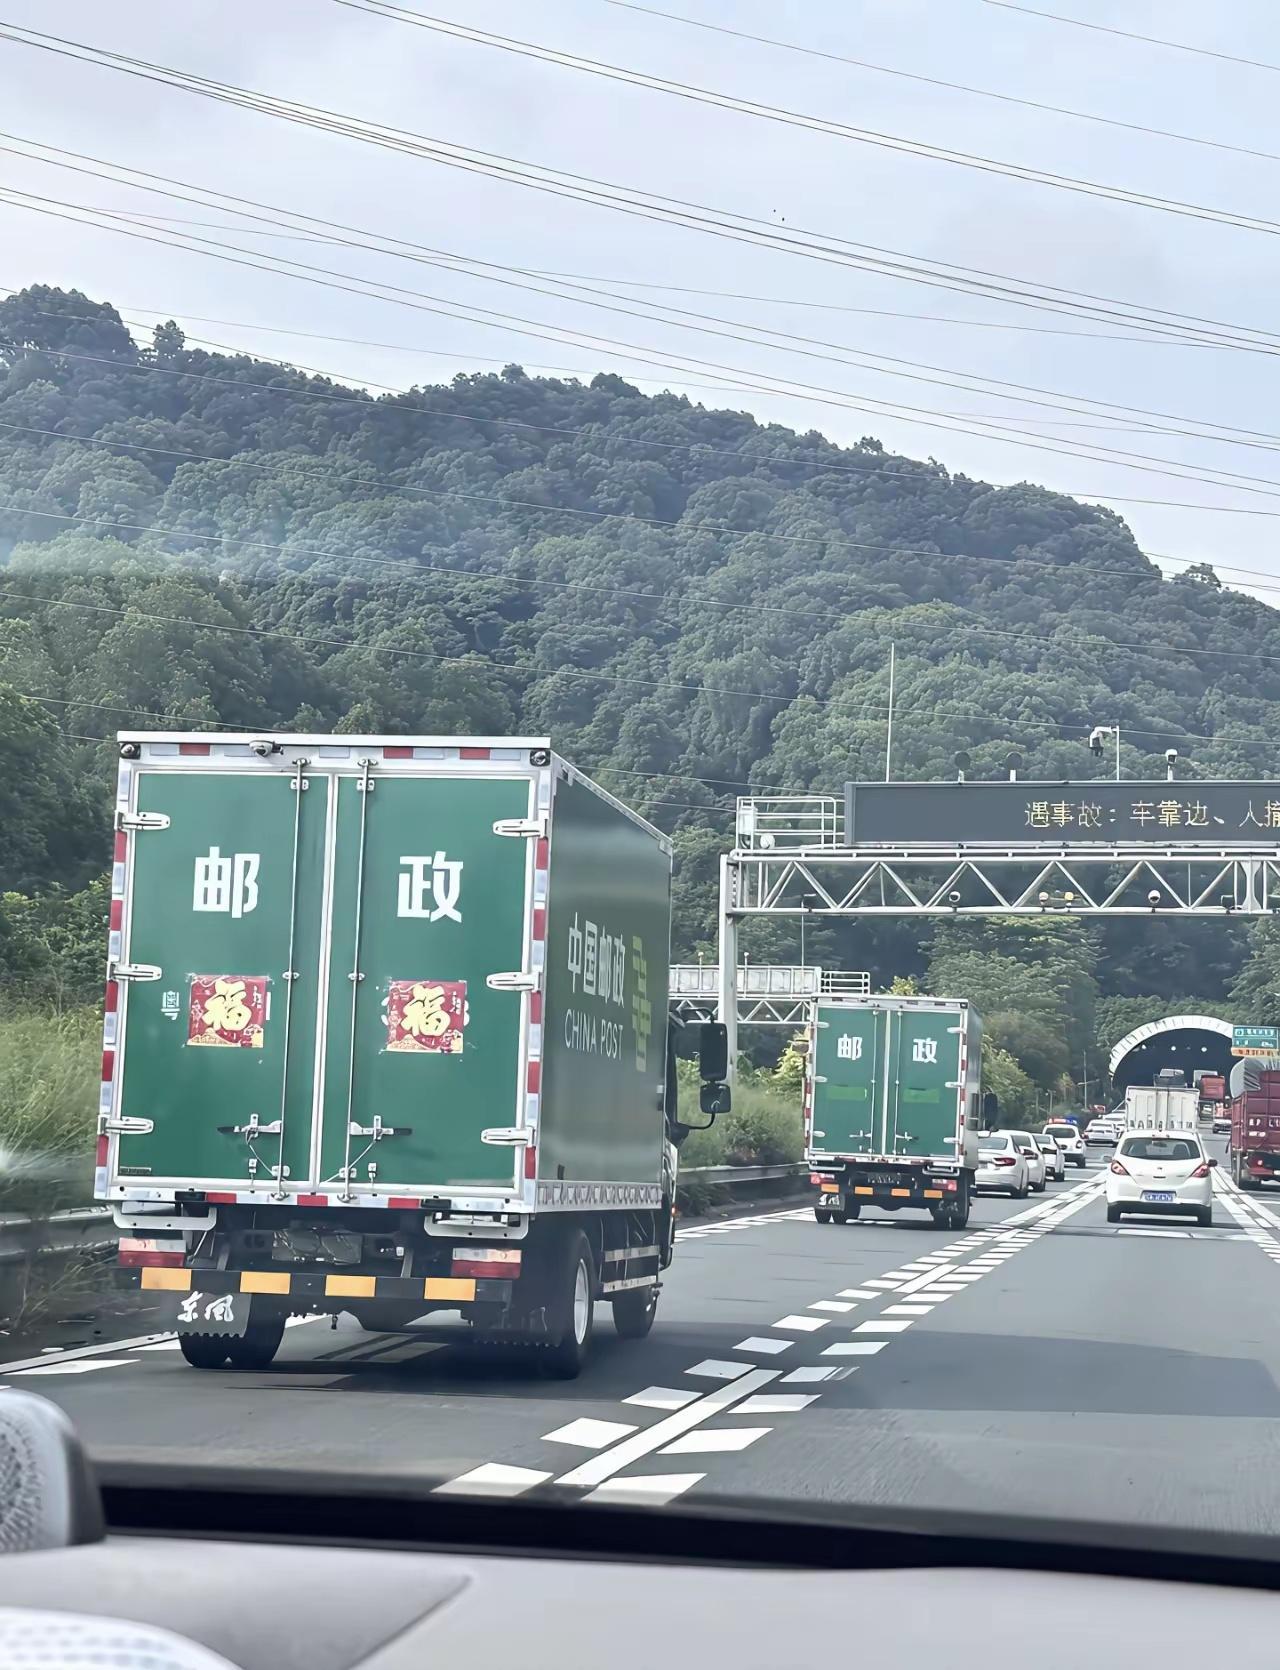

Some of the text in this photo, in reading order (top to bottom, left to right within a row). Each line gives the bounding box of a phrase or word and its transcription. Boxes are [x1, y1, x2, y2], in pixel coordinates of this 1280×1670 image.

[192, 846, 464, 923] 邮 政
[567, 911, 626, 1008] 中国邮政
[201, 979, 253, 1031] 福
[400, 983, 451, 1037] 福
[564, 1008, 624, 1061] CHINA POST
[177, 1290, 234, 1323] 东风
